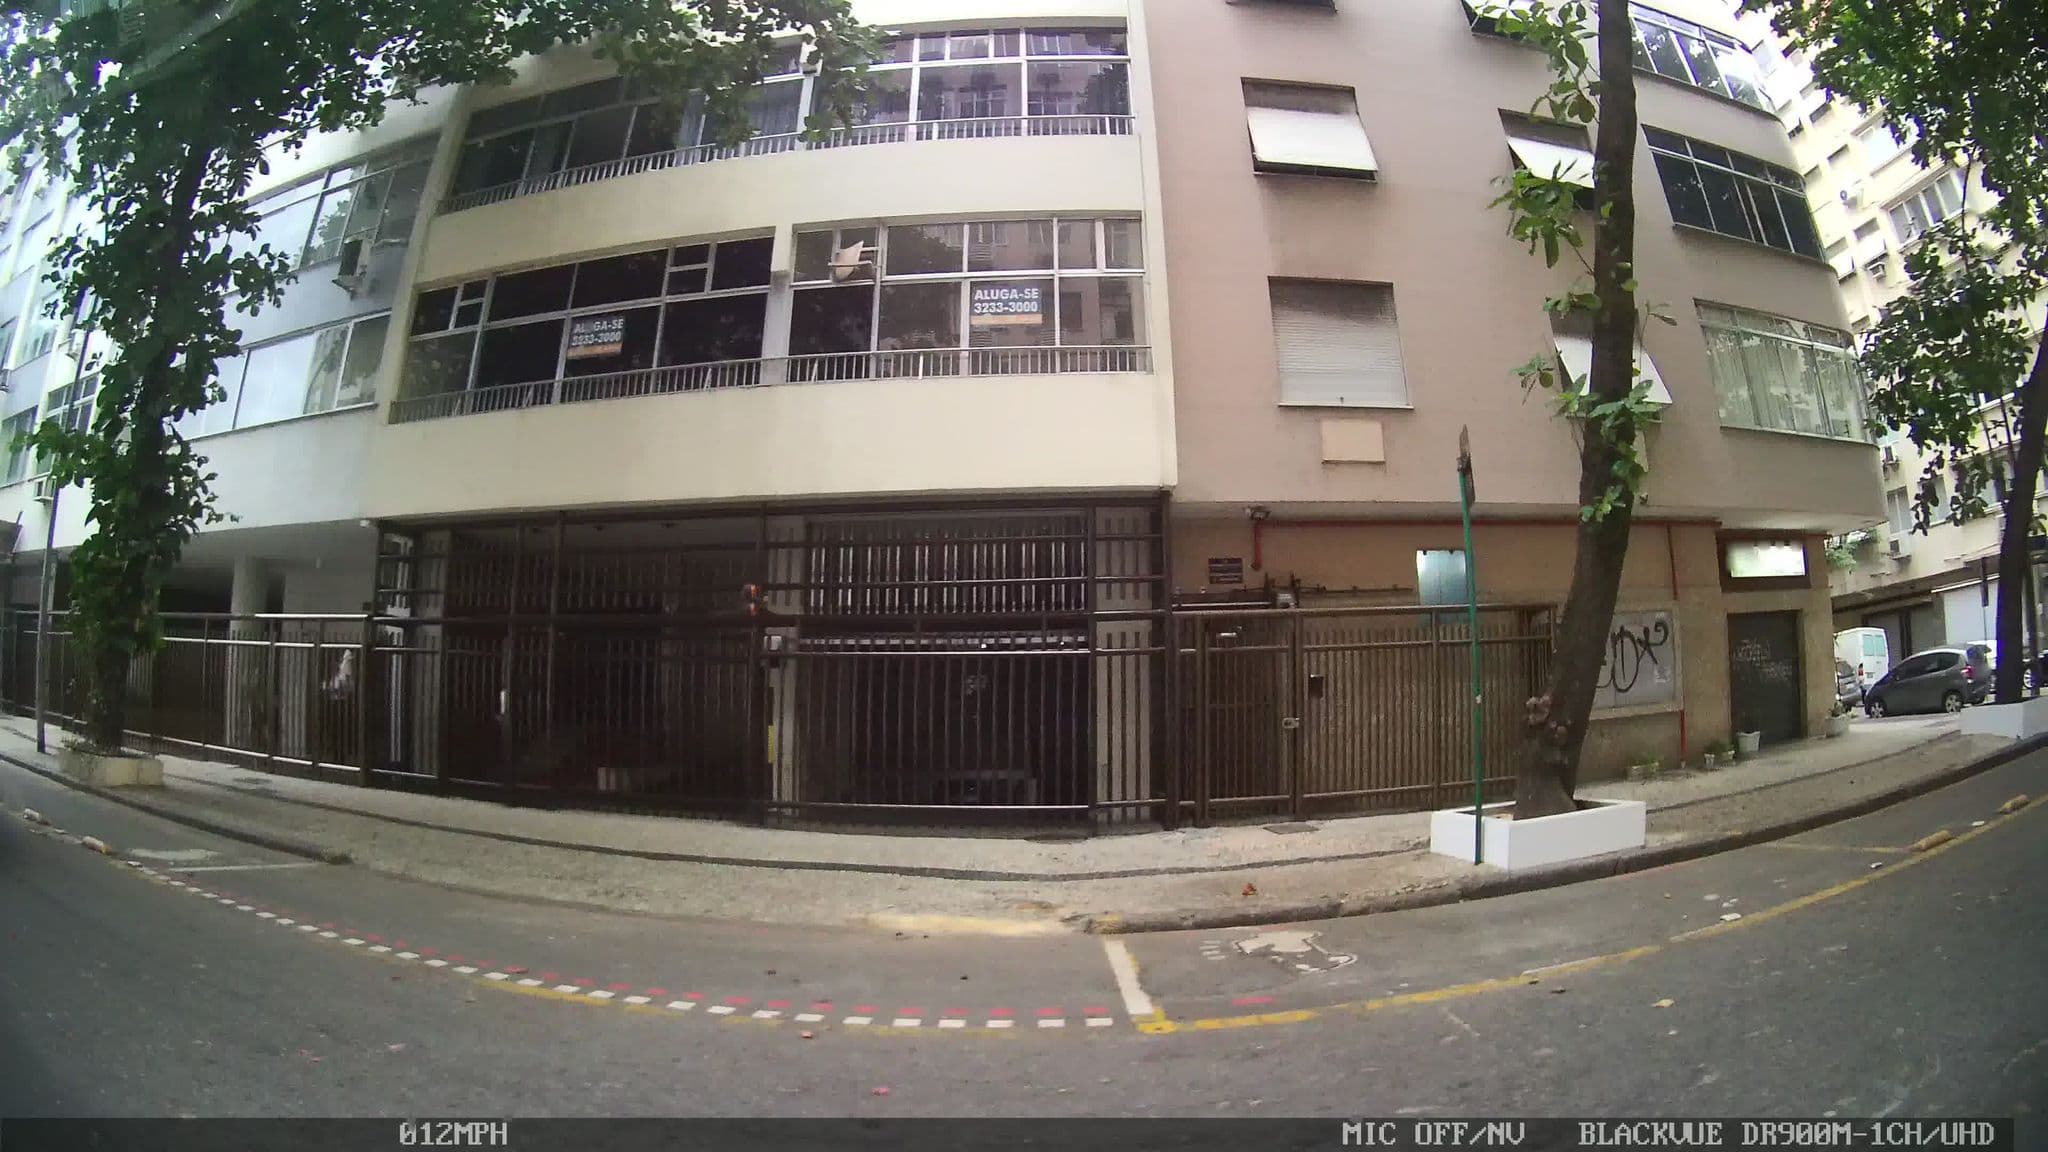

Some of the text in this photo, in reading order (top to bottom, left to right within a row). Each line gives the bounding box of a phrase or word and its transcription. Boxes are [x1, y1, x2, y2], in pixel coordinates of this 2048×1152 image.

[974, 288, 1040, 300] ALUGA-SE
[973, 301, 1038, 313] 3233-3000
[574, 318, 624, 334] ALGA-SE
